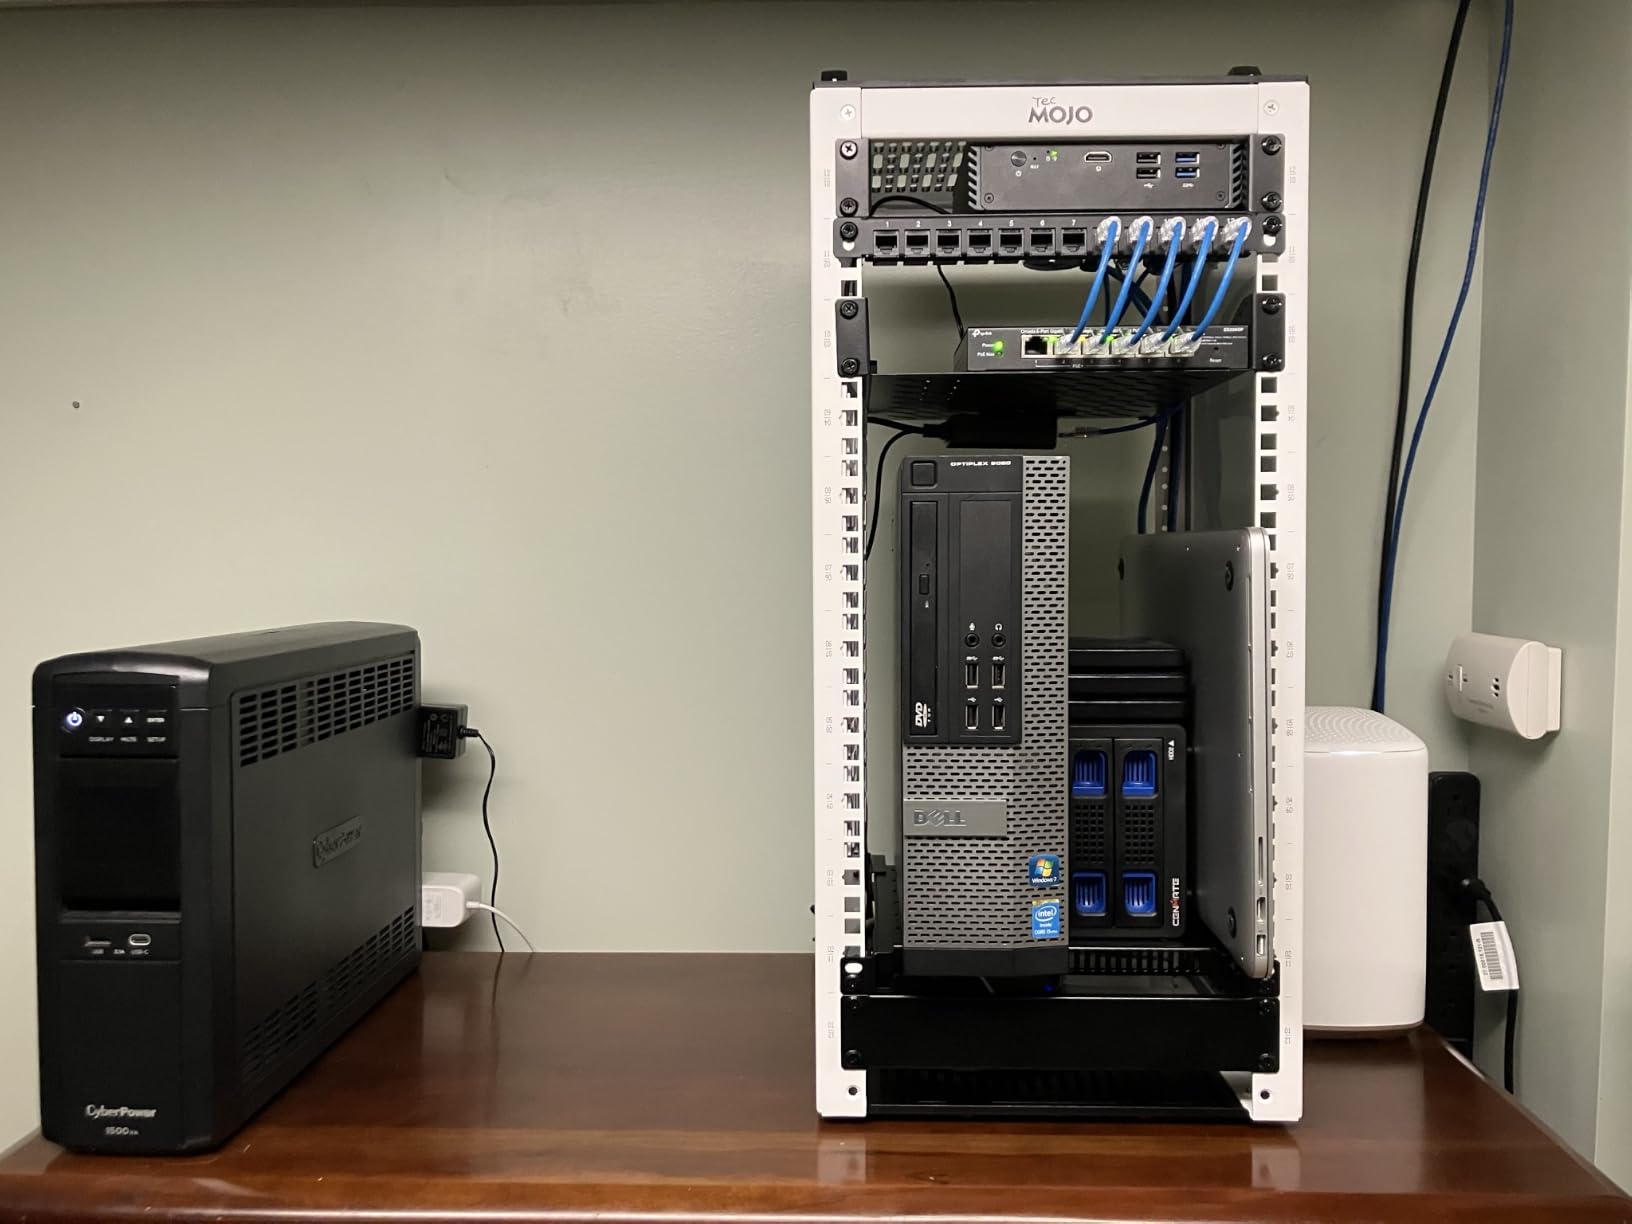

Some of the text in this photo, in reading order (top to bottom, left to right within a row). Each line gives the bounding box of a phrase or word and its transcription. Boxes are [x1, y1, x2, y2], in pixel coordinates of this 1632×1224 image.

[1032, 96, 1056, 107] Tec
[1028, 105, 1093, 125] MOJO
[915, 702, 923, 727] DVD
[913, 809, 968, 828] DELL
[1037, 909, 1054, 917] intel
[86, 1104, 157, 1119] CyberPower
